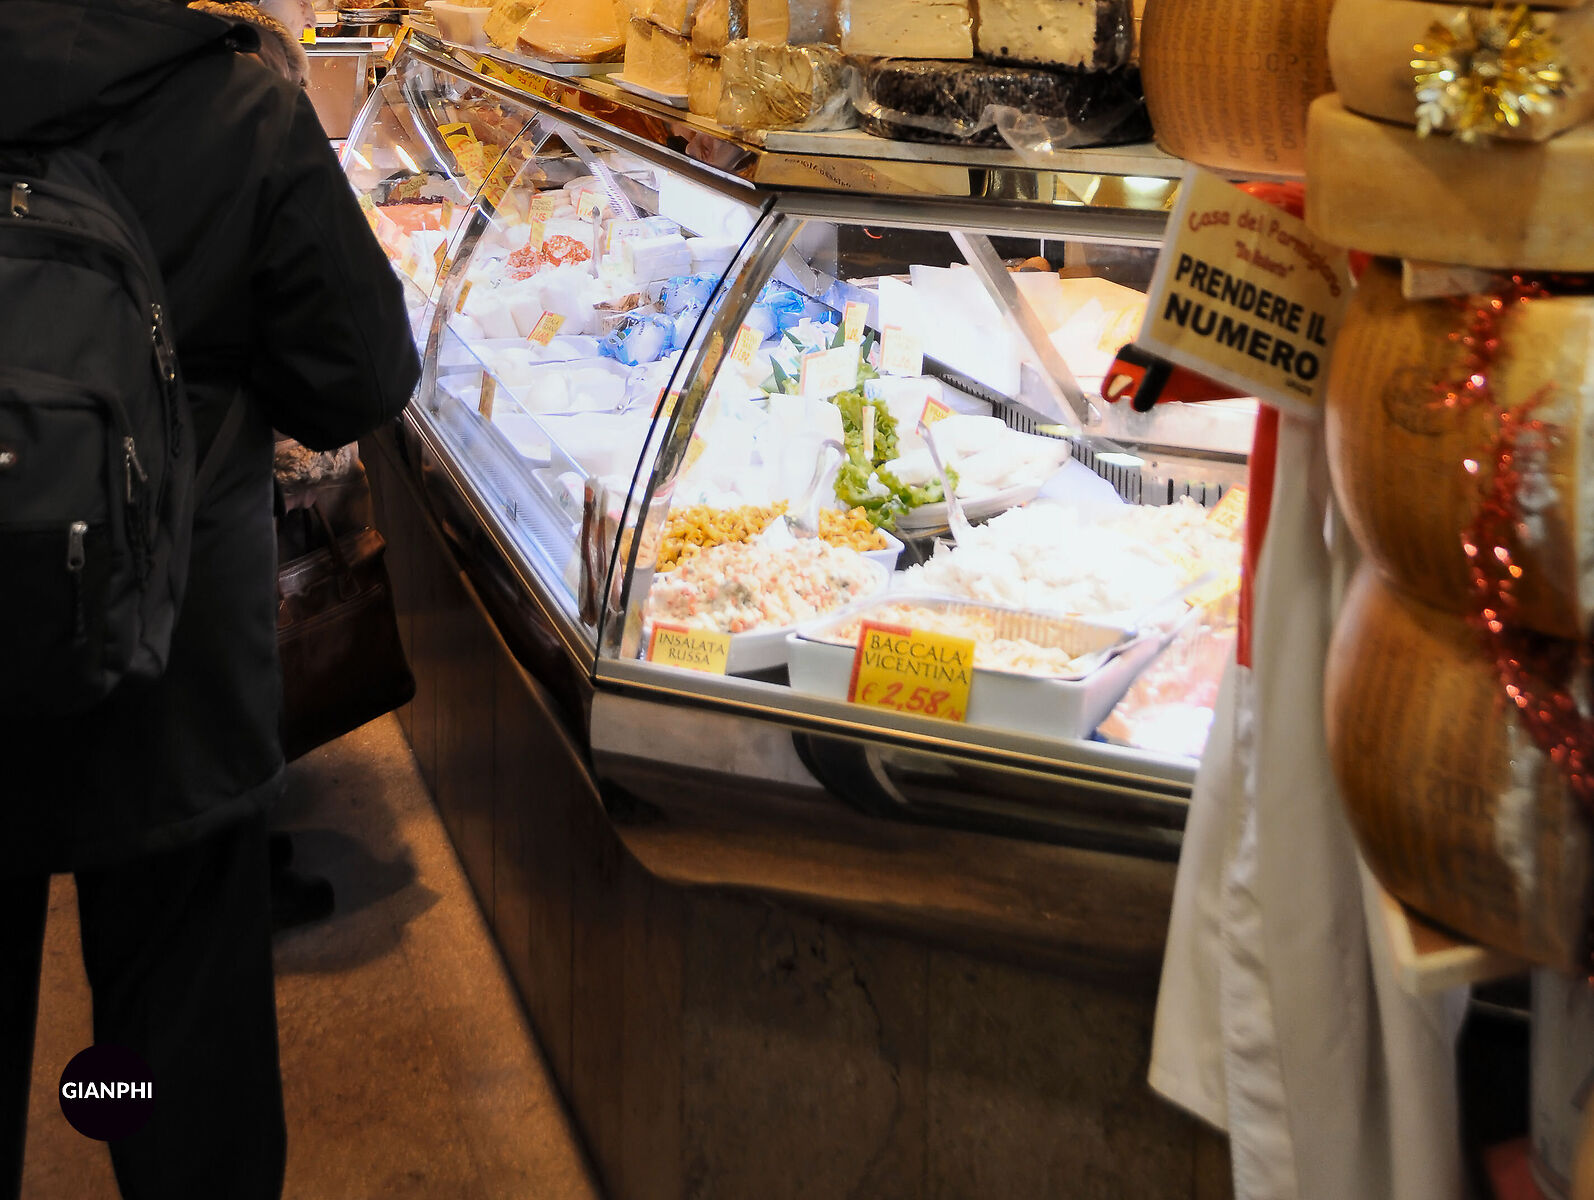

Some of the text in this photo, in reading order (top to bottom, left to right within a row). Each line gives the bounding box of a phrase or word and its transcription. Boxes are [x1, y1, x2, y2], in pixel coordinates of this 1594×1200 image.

[1188, 208, 1342, 298] Casa del Parmigiano
[1175, 253, 1327, 347] PRENDERE IL
[1163, 293, 1319, 381] NUMERO
[658, 632, 726, 656] INSALATA
[668, 647, 711, 666] RUSSA
[865, 652, 969, 685] VICENTINA
